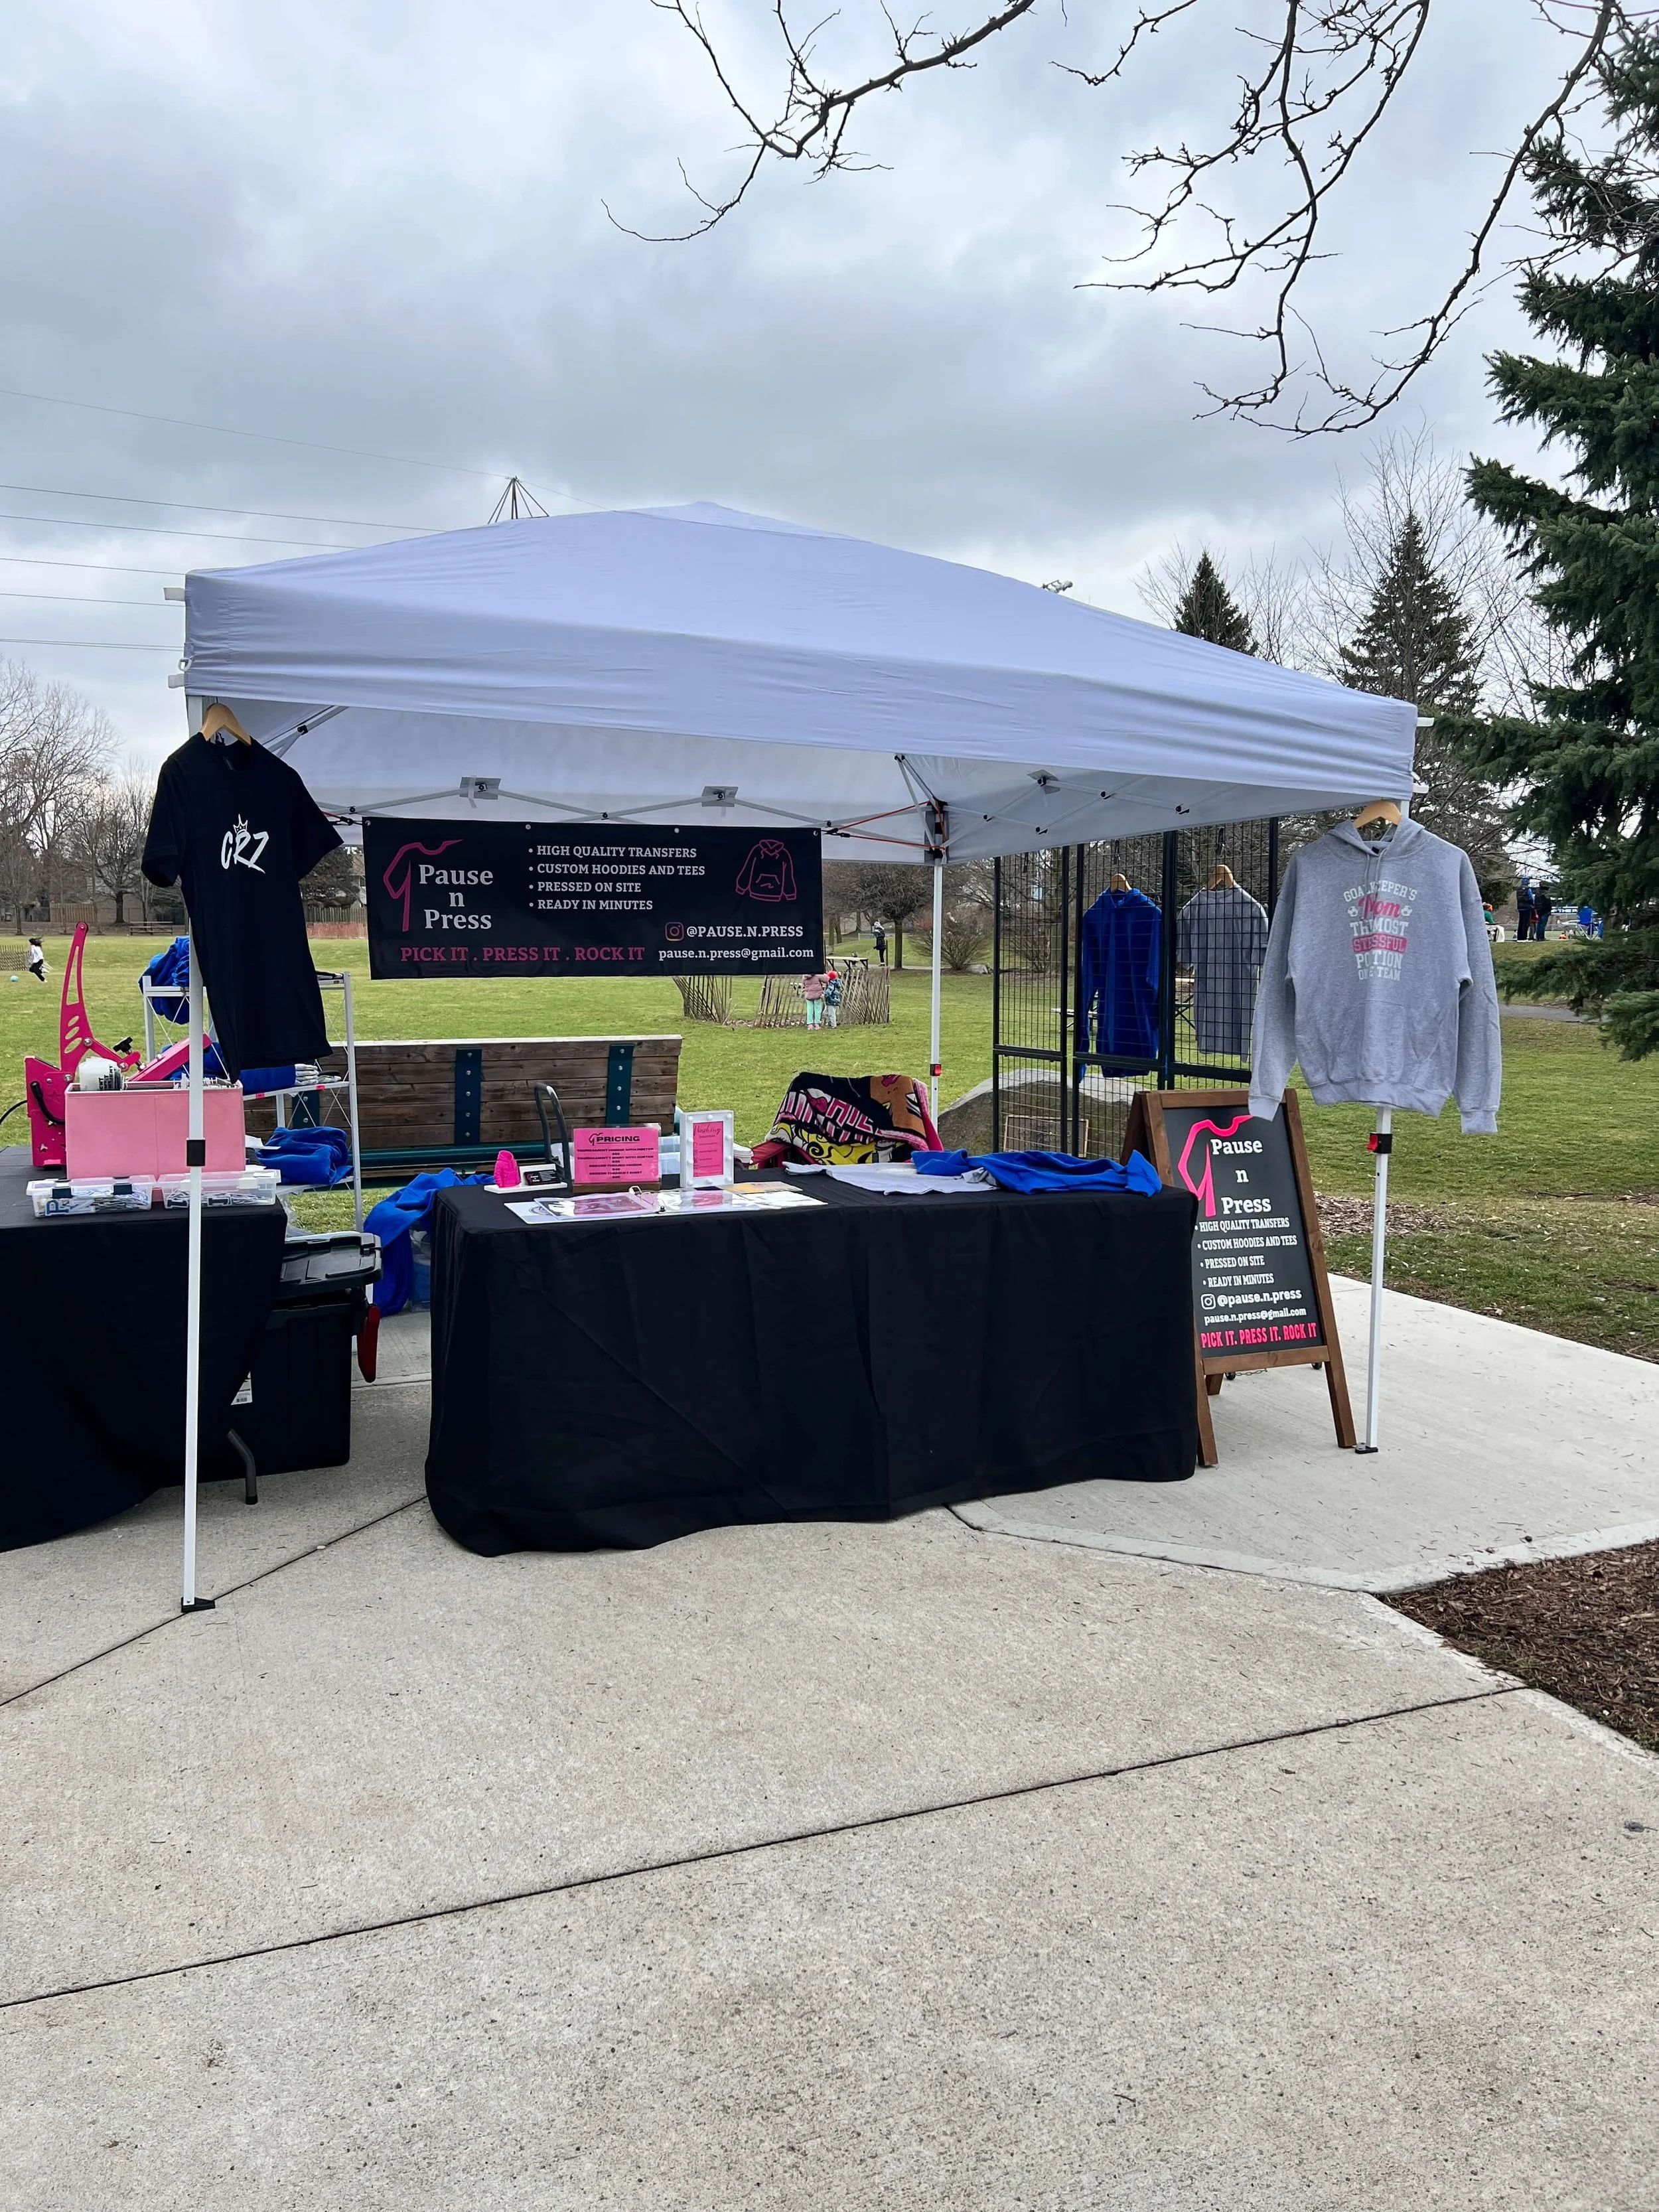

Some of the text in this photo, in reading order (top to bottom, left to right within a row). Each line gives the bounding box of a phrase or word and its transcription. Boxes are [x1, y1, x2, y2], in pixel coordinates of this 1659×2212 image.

[537, 846, 697, 858] HIGH QUALITY TRANSFERS
[418, 864, 493, 885] Pause
[537, 863, 705, 875] CUSTOM HOODIES AND TEES
[538, 881, 641, 892] PRESSED ON SITE
[449, 892, 465, 907] n
[538, 899, 653, 910] READY IN MINUTES
[423, 909, 492, 929] Press
[687, 926, 804, 938] @PAUSE.N.PRESS
[400, 947, 447, 961] PICK
[451, 947, 469, 961] IT
[482, 947, 539, 961] PRESS
[543, 947, 561, 961] IT
[574, 947, 624, 961] ROCK
[628, 947, 645, 960] IT
[658, 947, 814, 961] pause.n.press@gmail.com
[1210, 1139, 1263, 1155] Pause
[1236, 1169, 1249, 1183] n
[1221, 1197, 1271, 1215] Press
[1199, 1217, 1290, 1233] HIGH QUALITY TRANSFERS
[1202, 1235, 1297, 1250] CUSTOM HOODIES AND TEES
[1204, 1255, 1265, 1268] PRESSED ON SITE
[1208, 1273, 1274, 1288] READY IN MINUTES
[1217, 1290, 1302, 1307] @pause.n.press
[1204, 1307, 1307, 1325] pause.n.press@gmail.com
[1200, 1323, 1317, 1348] PICK IT. PRESS IT. ROCK IT
